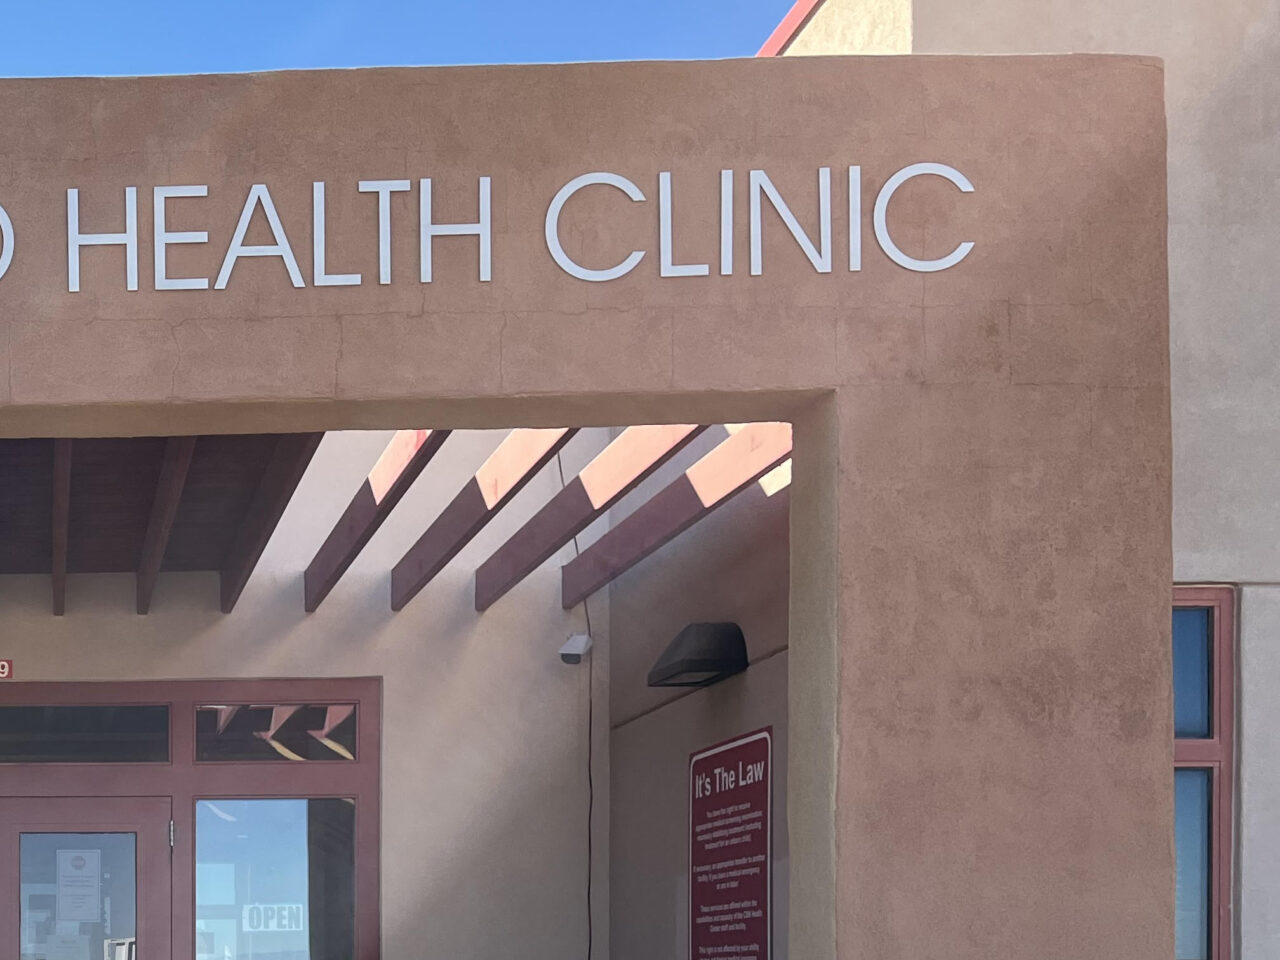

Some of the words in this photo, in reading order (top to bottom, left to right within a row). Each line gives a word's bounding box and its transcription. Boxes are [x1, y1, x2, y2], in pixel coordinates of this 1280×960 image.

[67, 176, 492, 292] HEALTH
[545, 161, 976, 282] CLINIC
[695, 773, 712, 799] It's
[714, 767, 736, 793] The
[739, 761, 765, 786] Law
[248, 905, 301, 930] OPEN
